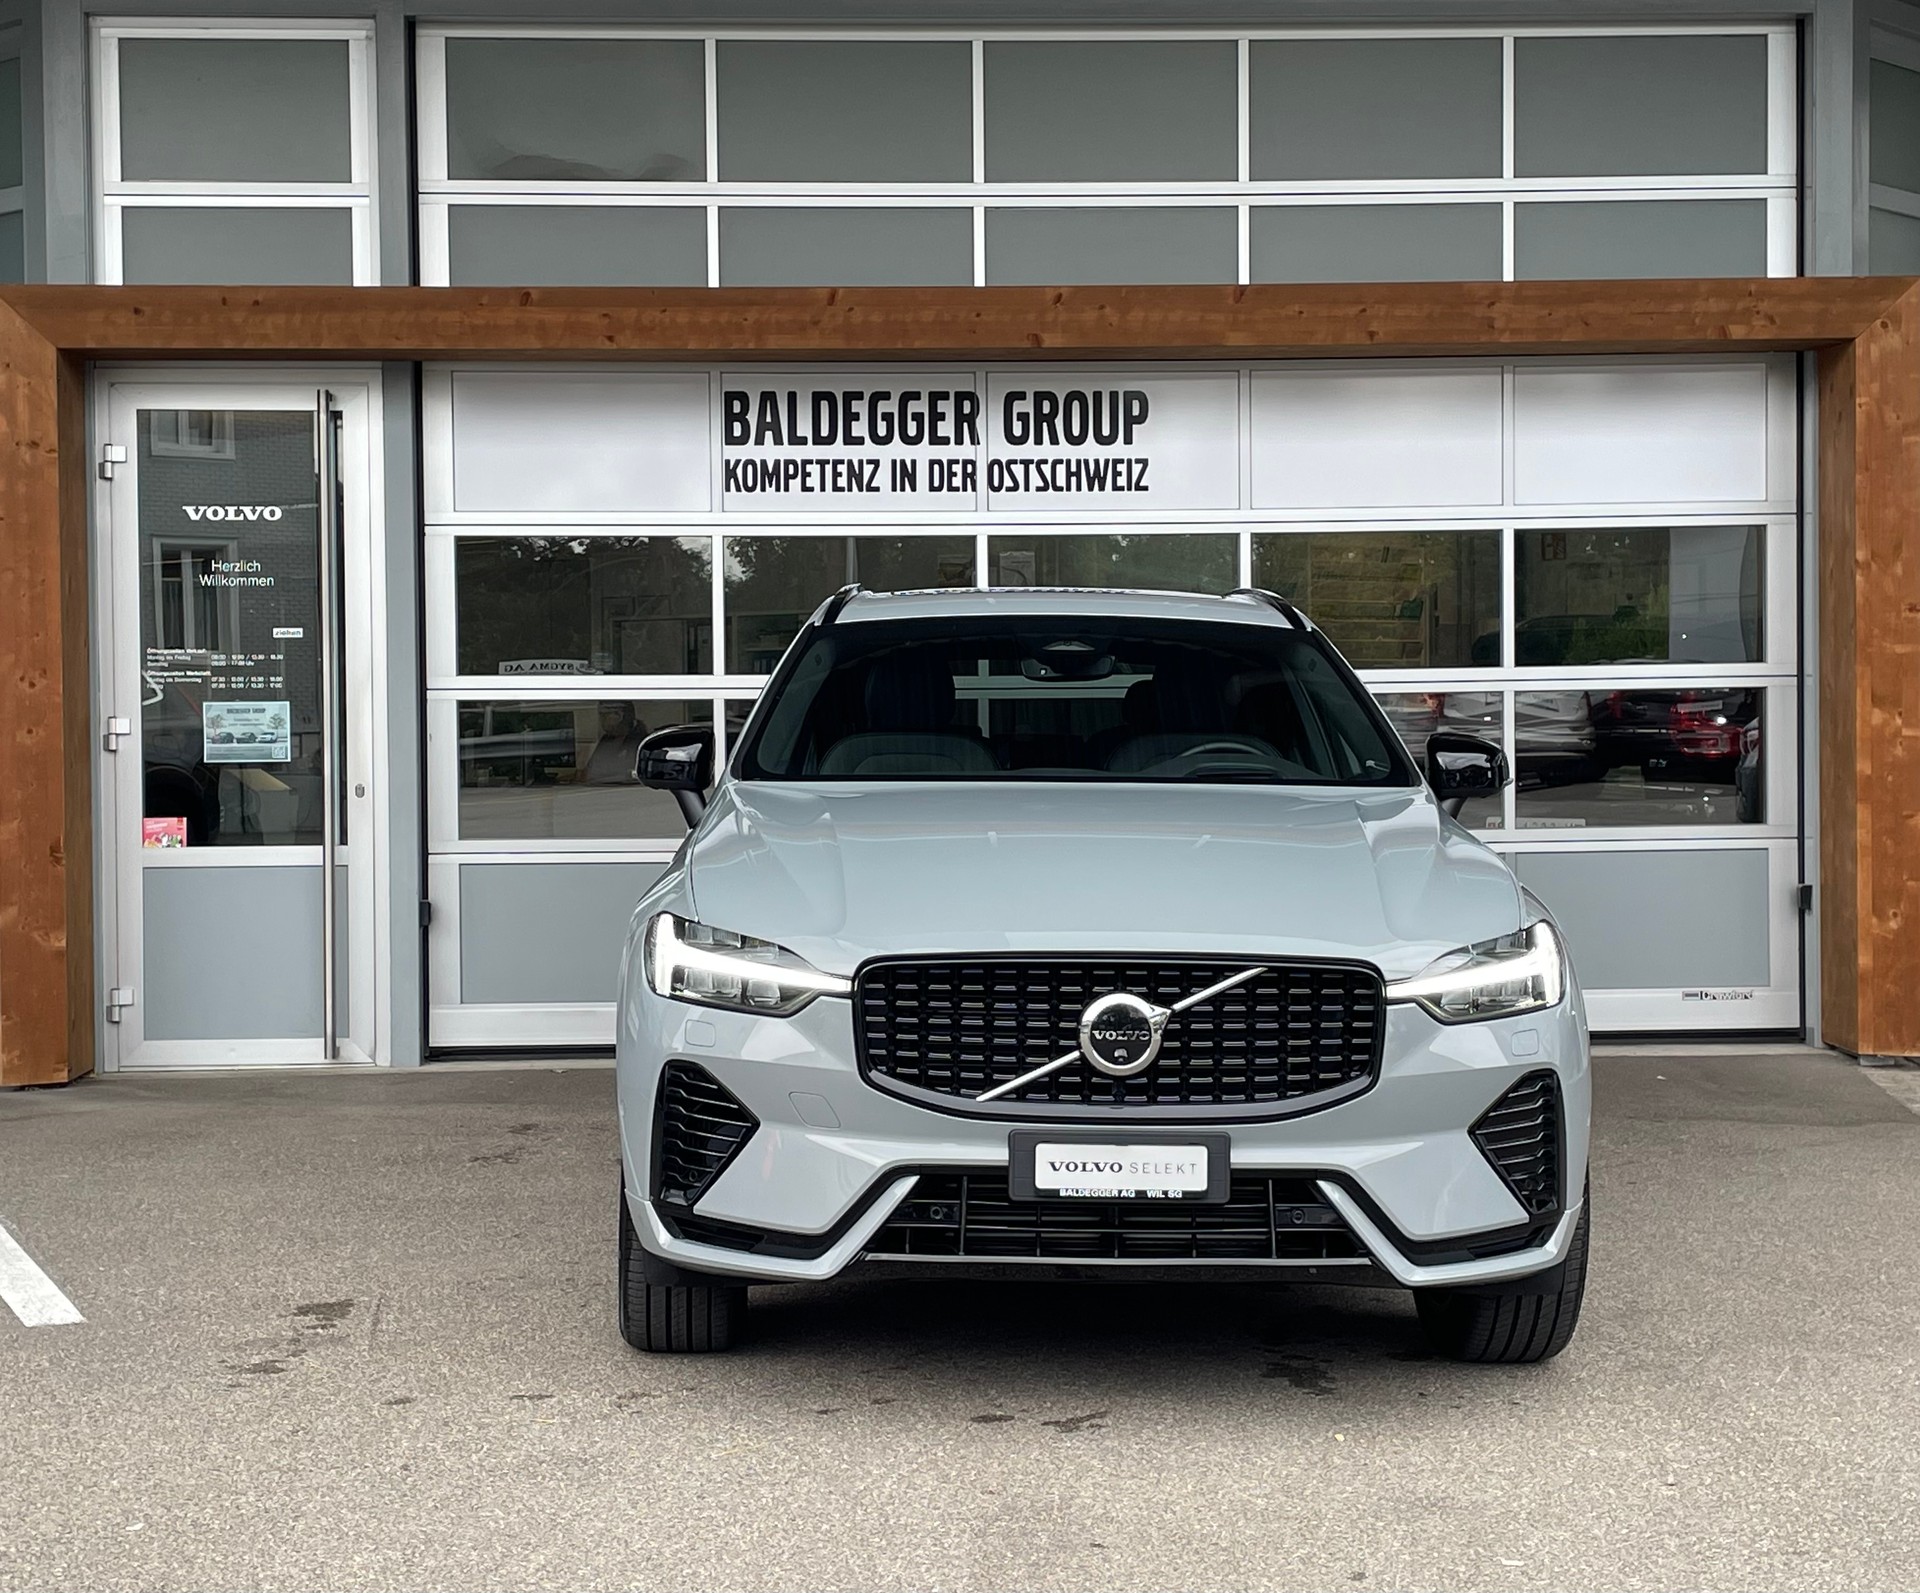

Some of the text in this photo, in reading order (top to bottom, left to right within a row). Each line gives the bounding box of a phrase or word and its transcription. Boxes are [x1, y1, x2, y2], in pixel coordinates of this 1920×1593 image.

[724, 390, 1149, 446] BALDEGGER GROUP
[724, 458, 1149, 493] KOMPETENZ IN DER OSTSCHWEIZ
[182, 506, 282, 520] VOLVO
[212, 560, 261, 572] Herzlich
[199, 574, 274, 587] Willkommen
[1092, 1030, 1150, 1041] VOLVO
[1049, 1161, 1198, 1175] VOLVO SELEKT
[1059, 1188, 1183, 1198] BALDEGGER AG WIL SG
